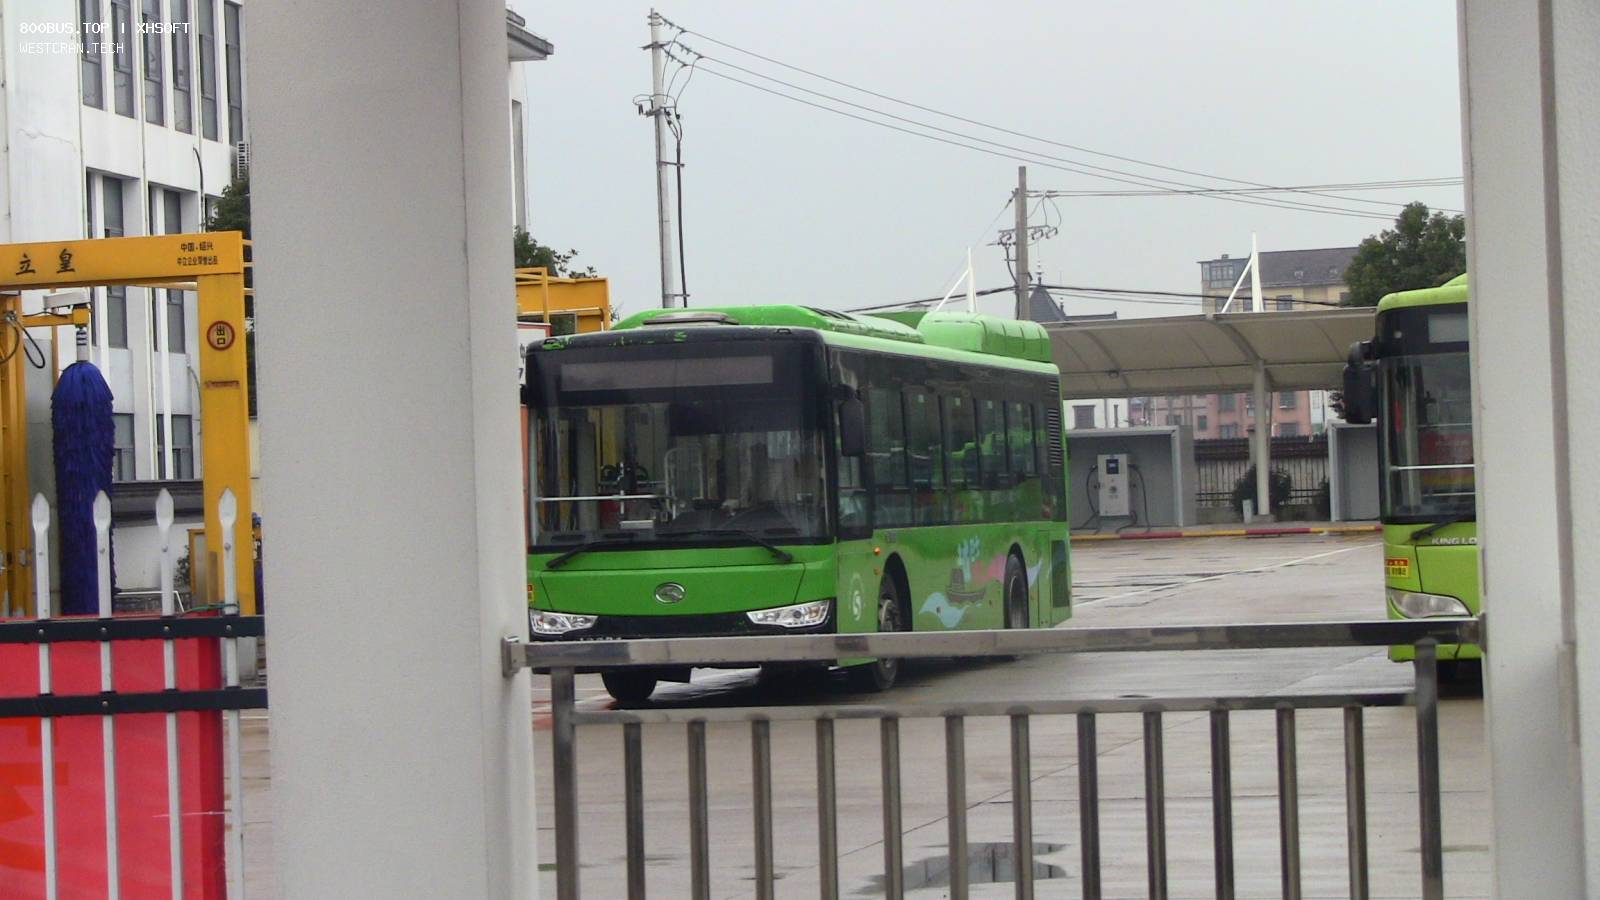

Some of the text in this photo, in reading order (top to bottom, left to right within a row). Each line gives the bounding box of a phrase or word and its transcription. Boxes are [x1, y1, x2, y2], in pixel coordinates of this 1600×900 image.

[15, 248, 76, 276] 立皇
[216, 325, 226, 345] 出口
[1431, 537, 1459, 545] KING
